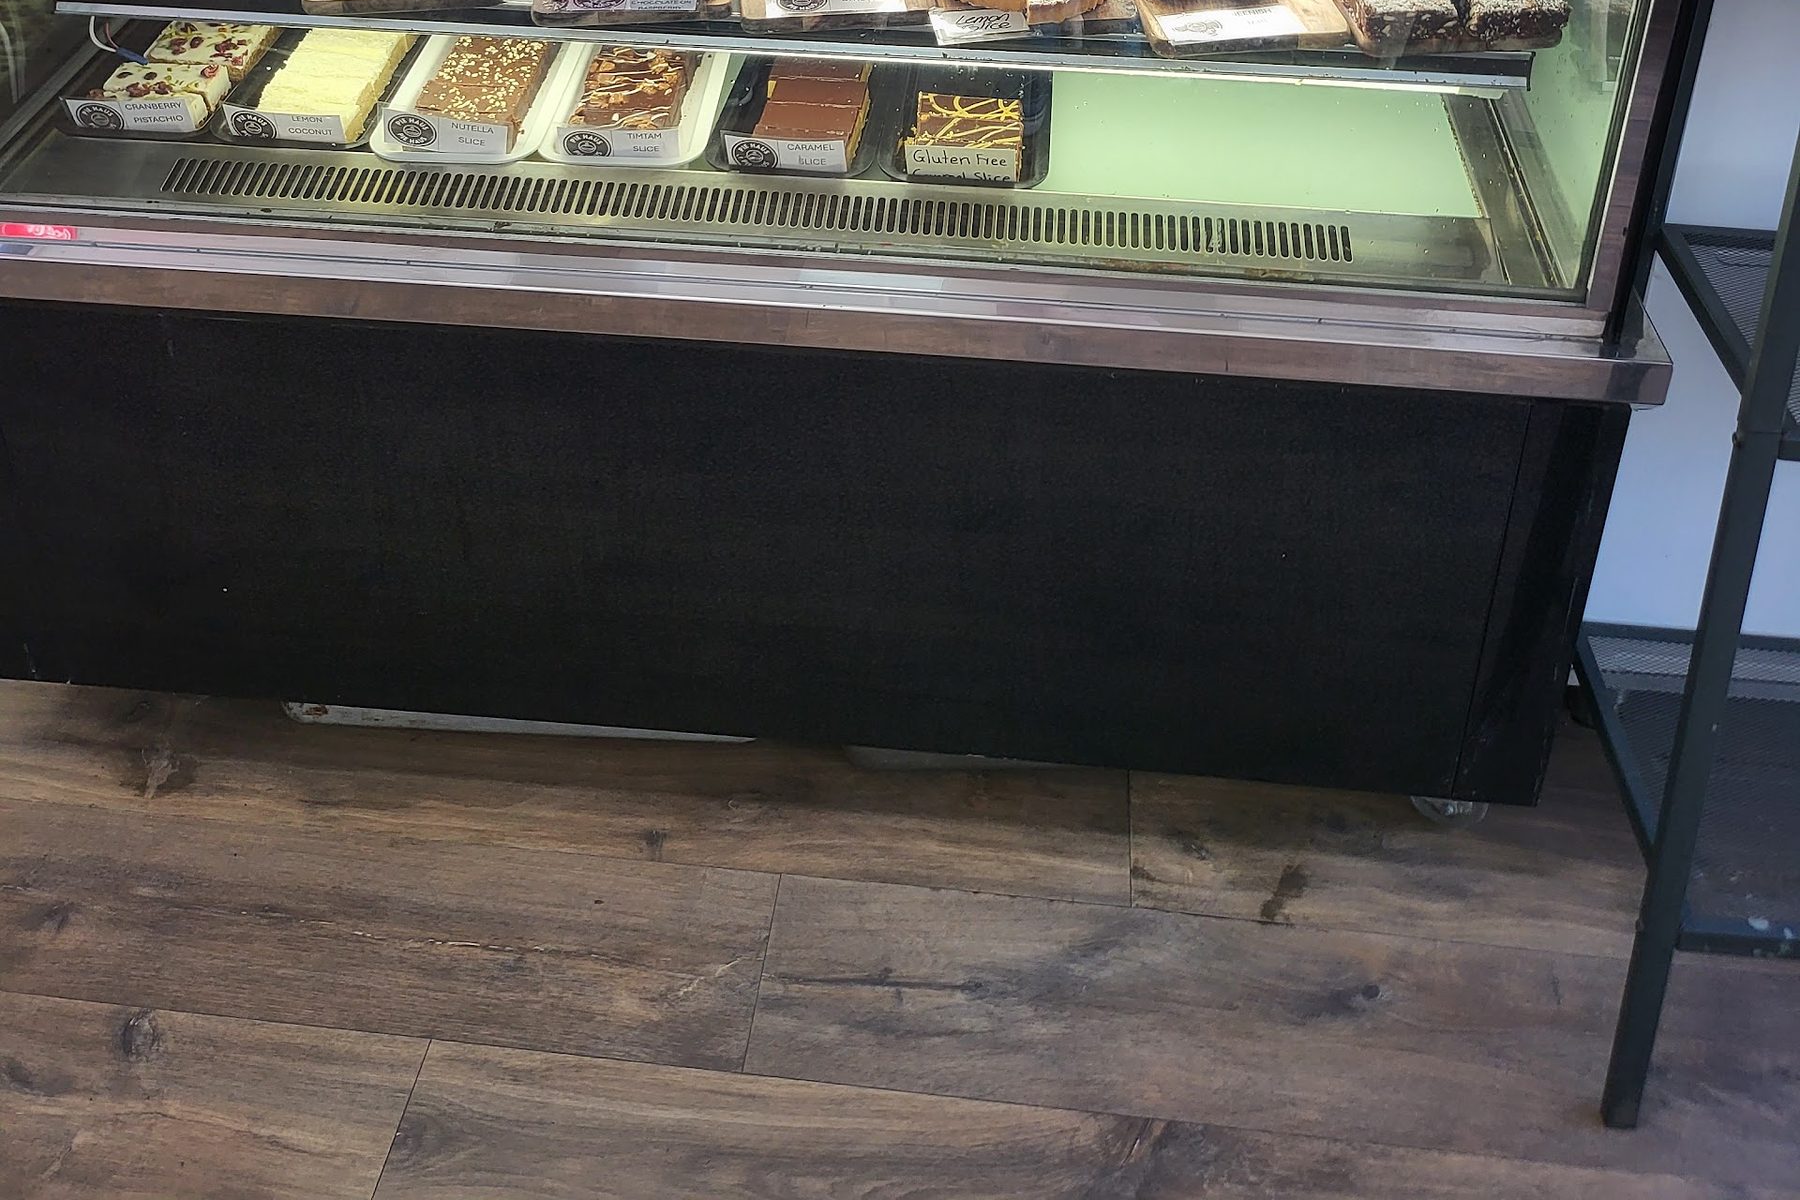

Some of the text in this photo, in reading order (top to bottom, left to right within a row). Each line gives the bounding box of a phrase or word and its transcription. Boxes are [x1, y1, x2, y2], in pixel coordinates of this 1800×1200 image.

[956, 13, 1010, 24] Lemon
[124, 102, 182, 110] CRANBERRY
[133, 114, 184, 123] PISTACHIO
[291, 115, 323, 123] LEMON
[288, 127, 333, 136] COCONUT
[451, 121, 494, 134] NUTELLA
[458, 136, 486, 146] SLICE
[786, 143, 835, 151] CARAMEL
[799, 157, 827, 165] SLICE
[913, 149, 971, 165] Gluten
[976, 153, 1008, 166] Free
